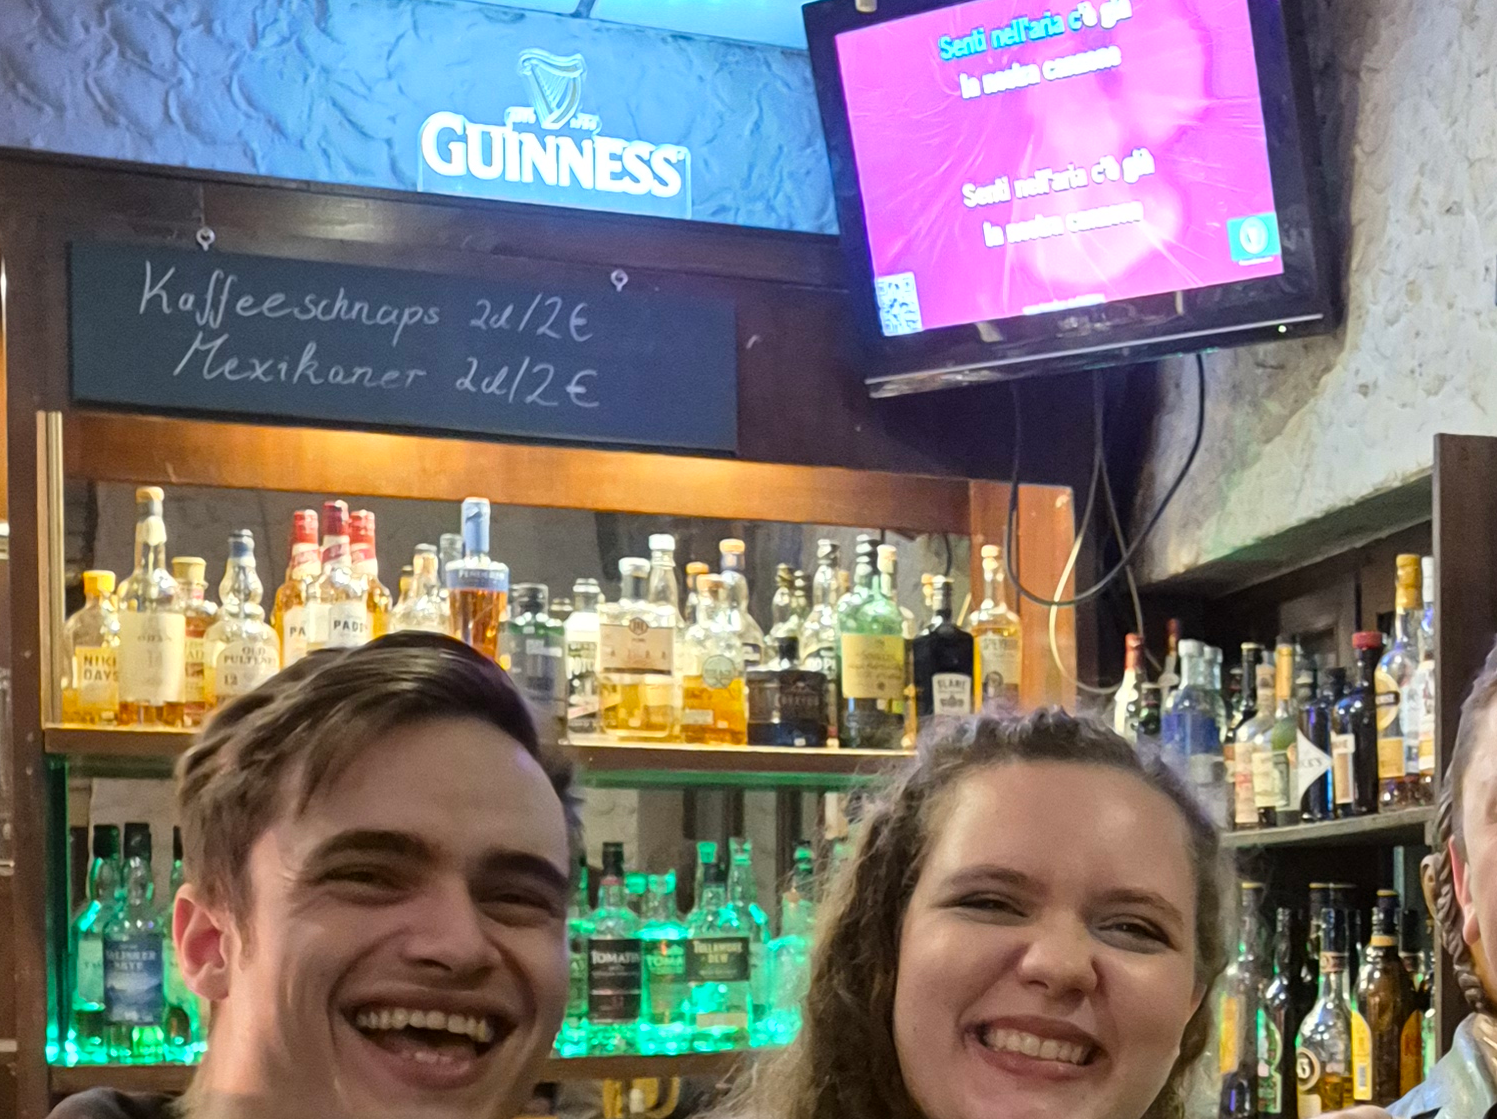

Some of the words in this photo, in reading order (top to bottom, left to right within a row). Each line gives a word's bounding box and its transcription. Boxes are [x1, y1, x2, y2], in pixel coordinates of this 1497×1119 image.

[421, 111, 684, 198] GUINNESS
[139, 260, 440, 348] Kaffeeschnaps
[173, 331, 427, 389] Mexikaner
